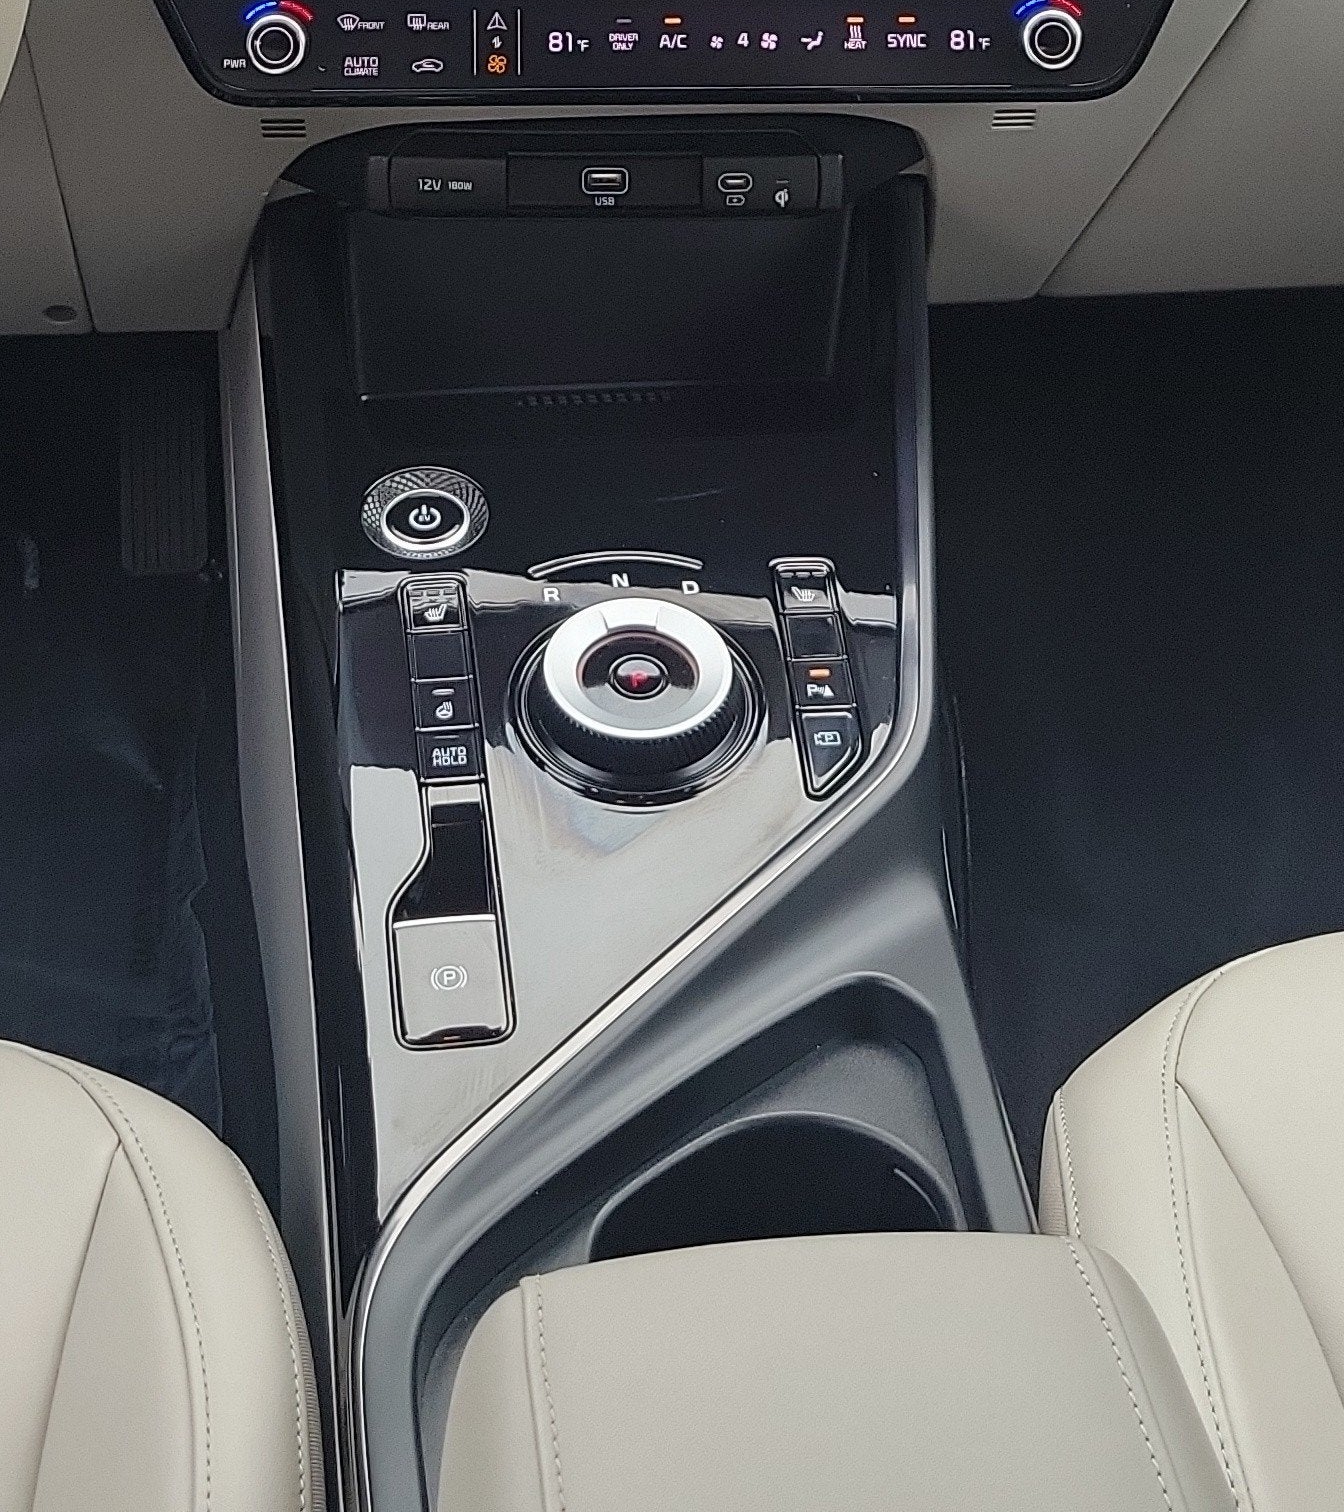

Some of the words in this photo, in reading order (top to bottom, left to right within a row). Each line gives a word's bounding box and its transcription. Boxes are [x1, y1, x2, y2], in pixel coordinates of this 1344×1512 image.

[357, 21, 386, 31] FRONT
[427, 21, 450, 31] REAR
[608, 32, 639, 42] DRIVER
[659, 33, 688, 50] A/C
[737, 32, 750, 48] 4
[886, 32, 928, 49] SYNC
[612, 41, 634, 51] ONLY
[843, 39, 868, 50] HEAT
[223, 58, 247, 70] PWR
[344, 56, 379, 68] AUTO
[344, 67, 379, 77] CLIMATE
[418, 178, 442, 192] 12V
[594, 195, 616, 207] USB
[613, 574, 629, 588] N
[682, 580, 699, 595] D
[543, 587, 560, 602] R
[633, 672, 648, 687] P
[432, 746, 467, 756] AUTO
[433, 755, 468, 767] HOLD
